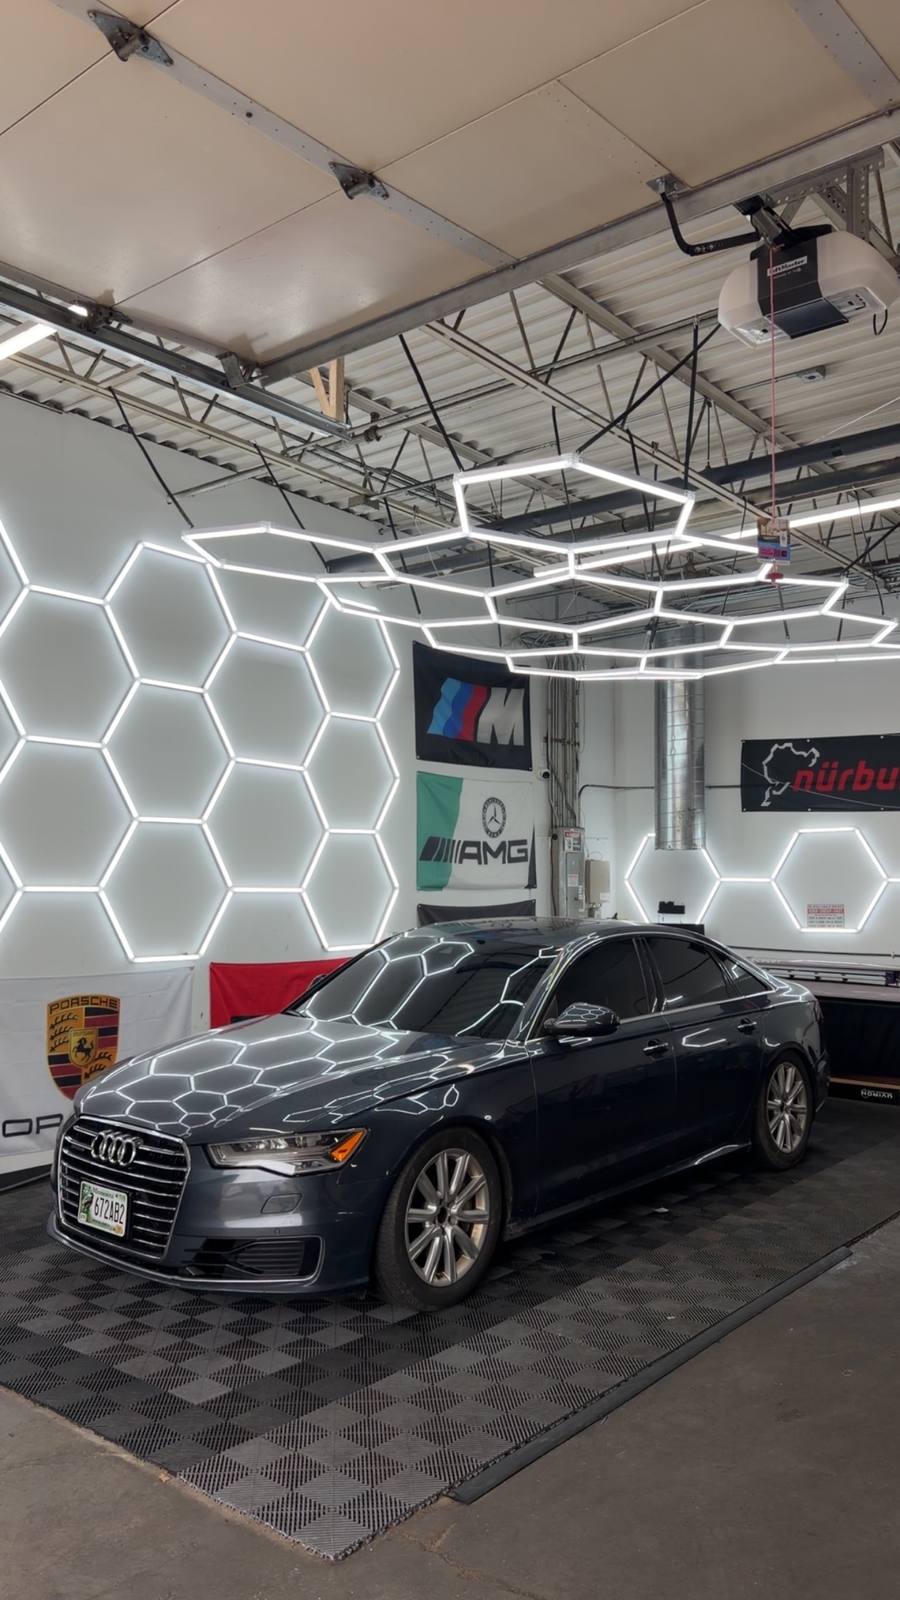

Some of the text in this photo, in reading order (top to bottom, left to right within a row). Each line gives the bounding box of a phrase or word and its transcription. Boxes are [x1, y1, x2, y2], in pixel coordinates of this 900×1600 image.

[792, 759, 900, 792] nürbu
[458, 839, 528, 865] AMG
[48, 996, 118, 1015] PORSCHE
[94, 1197, 125, 1225] 672AB2
